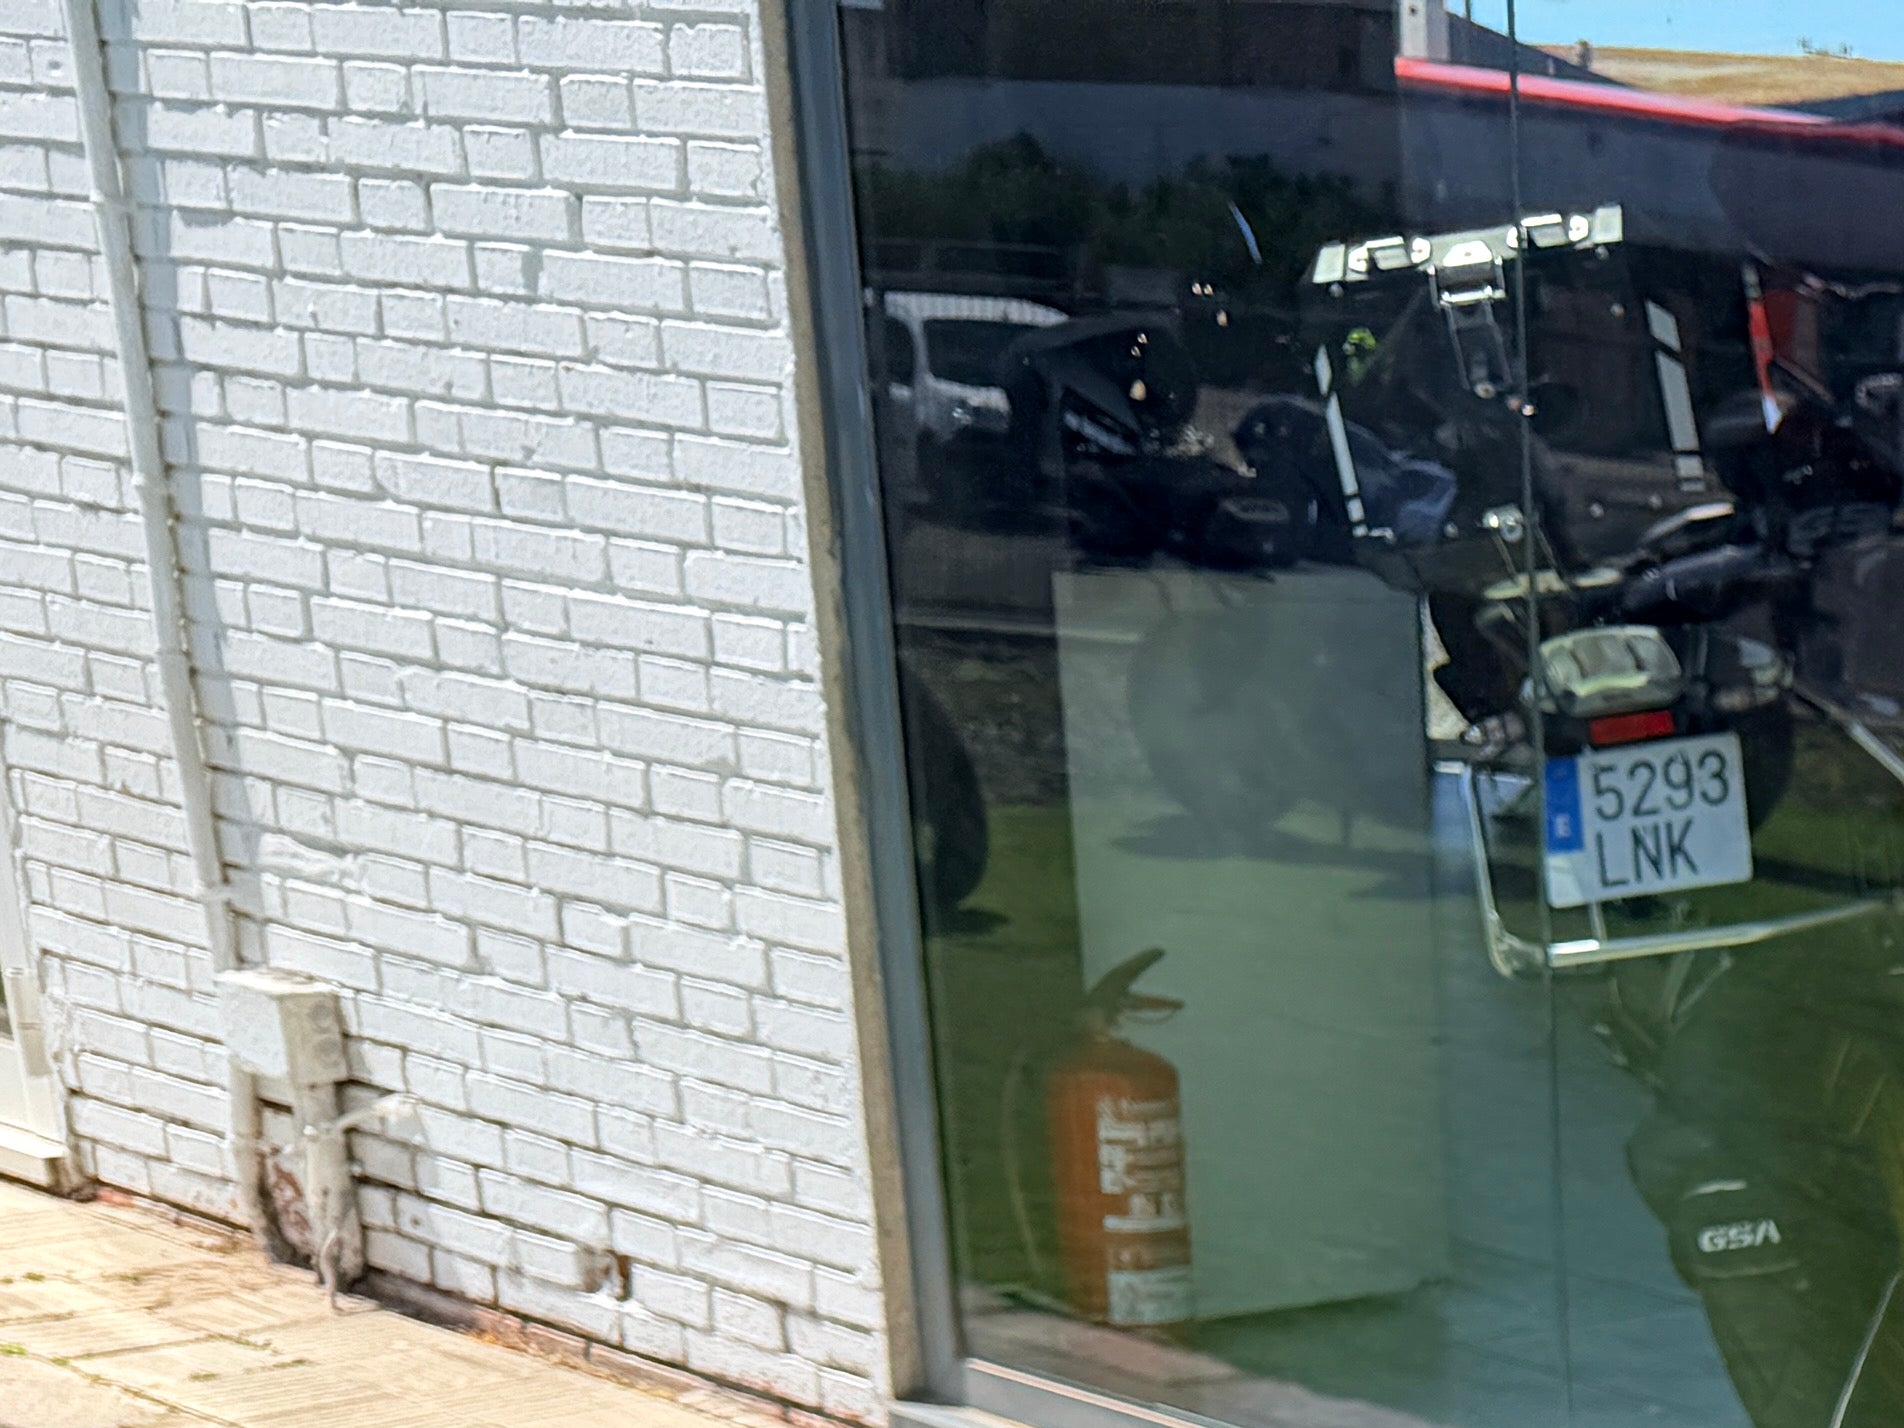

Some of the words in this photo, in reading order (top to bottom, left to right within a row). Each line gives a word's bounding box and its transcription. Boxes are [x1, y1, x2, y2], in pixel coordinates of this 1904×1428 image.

[1591, 747, 1730, 822] 5293
[1595, 817, 1698, 888] LNK
[1696, 1218, 1783, 1254] GSA
